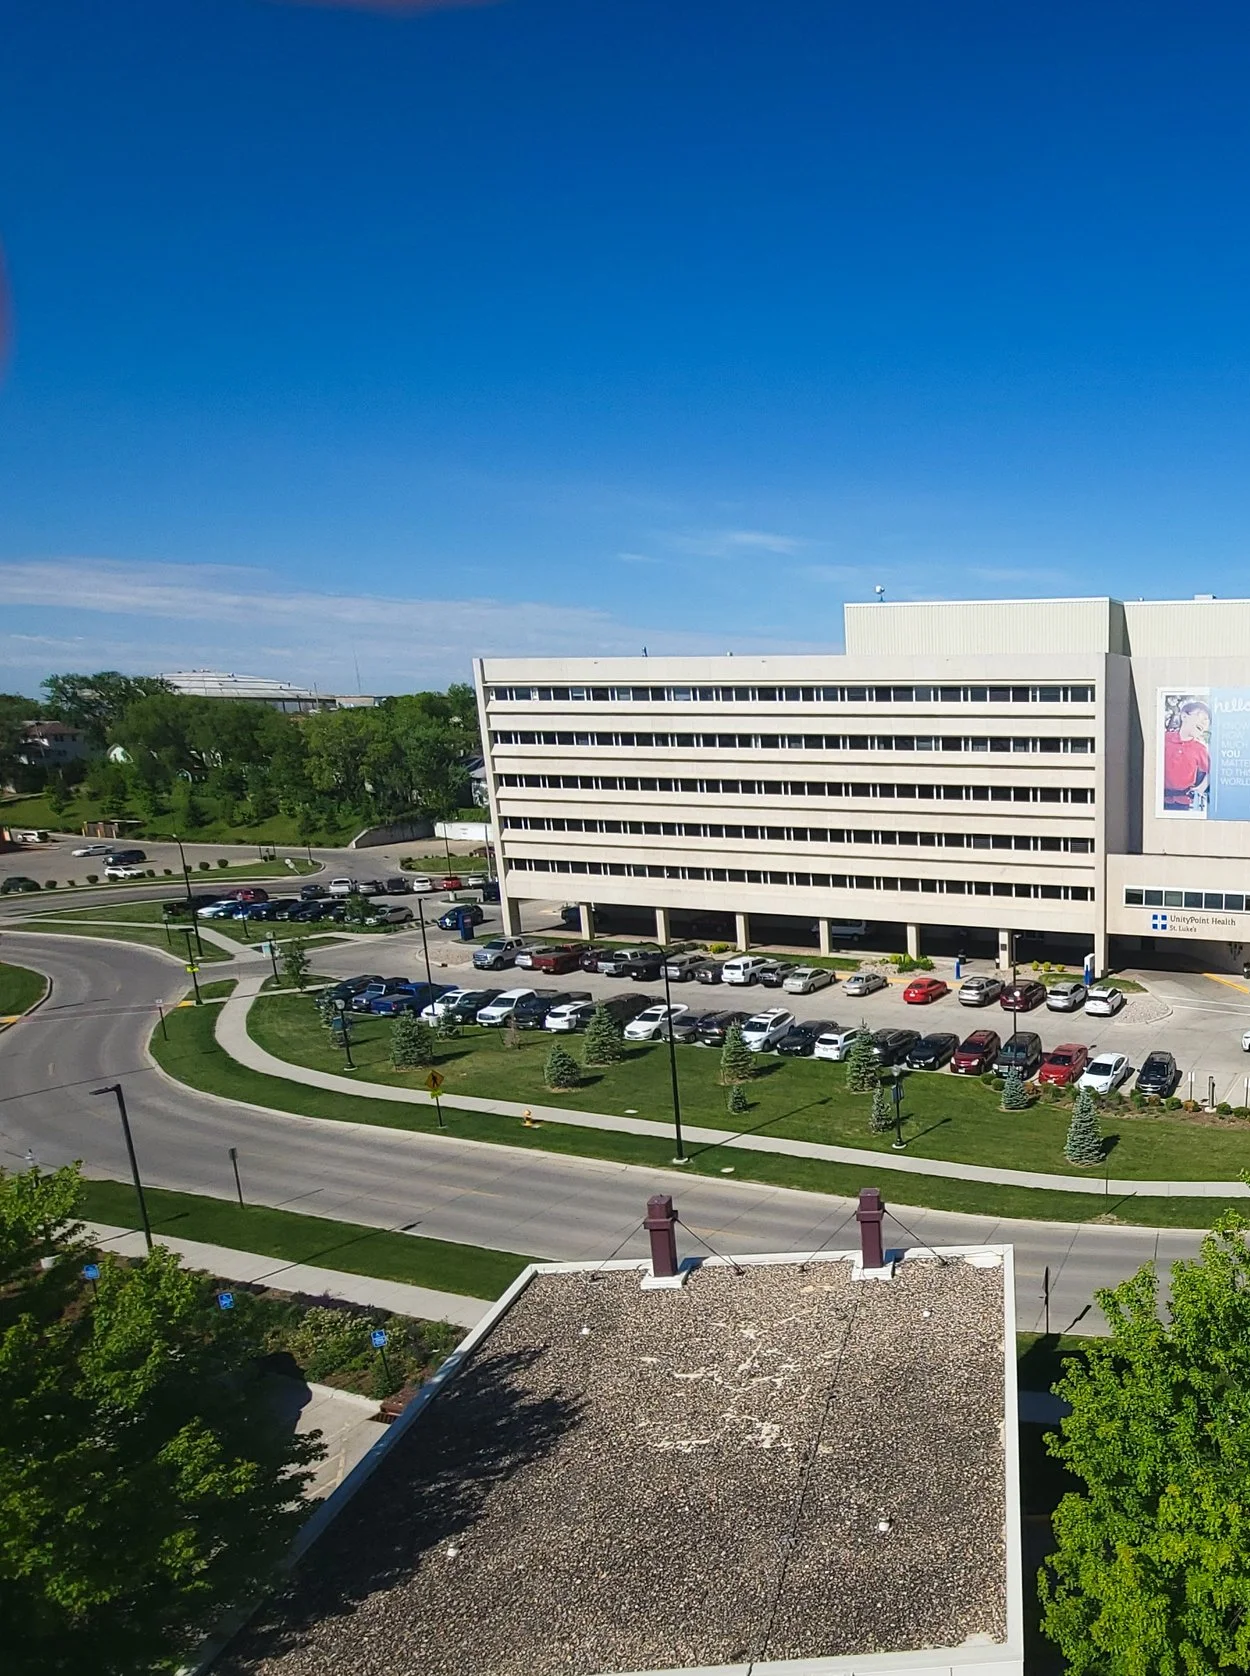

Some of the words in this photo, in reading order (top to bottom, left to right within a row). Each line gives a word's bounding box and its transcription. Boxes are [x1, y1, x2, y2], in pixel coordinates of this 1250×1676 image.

[1221, 740, 1248, 749] MUCH
[1221, 750, 1240, 758] YOU
[1221, 768, 1233, 777] TO
[1170, 915, 1209, 925] UnityPoint
[1211, 917, 1236, 926] Health
